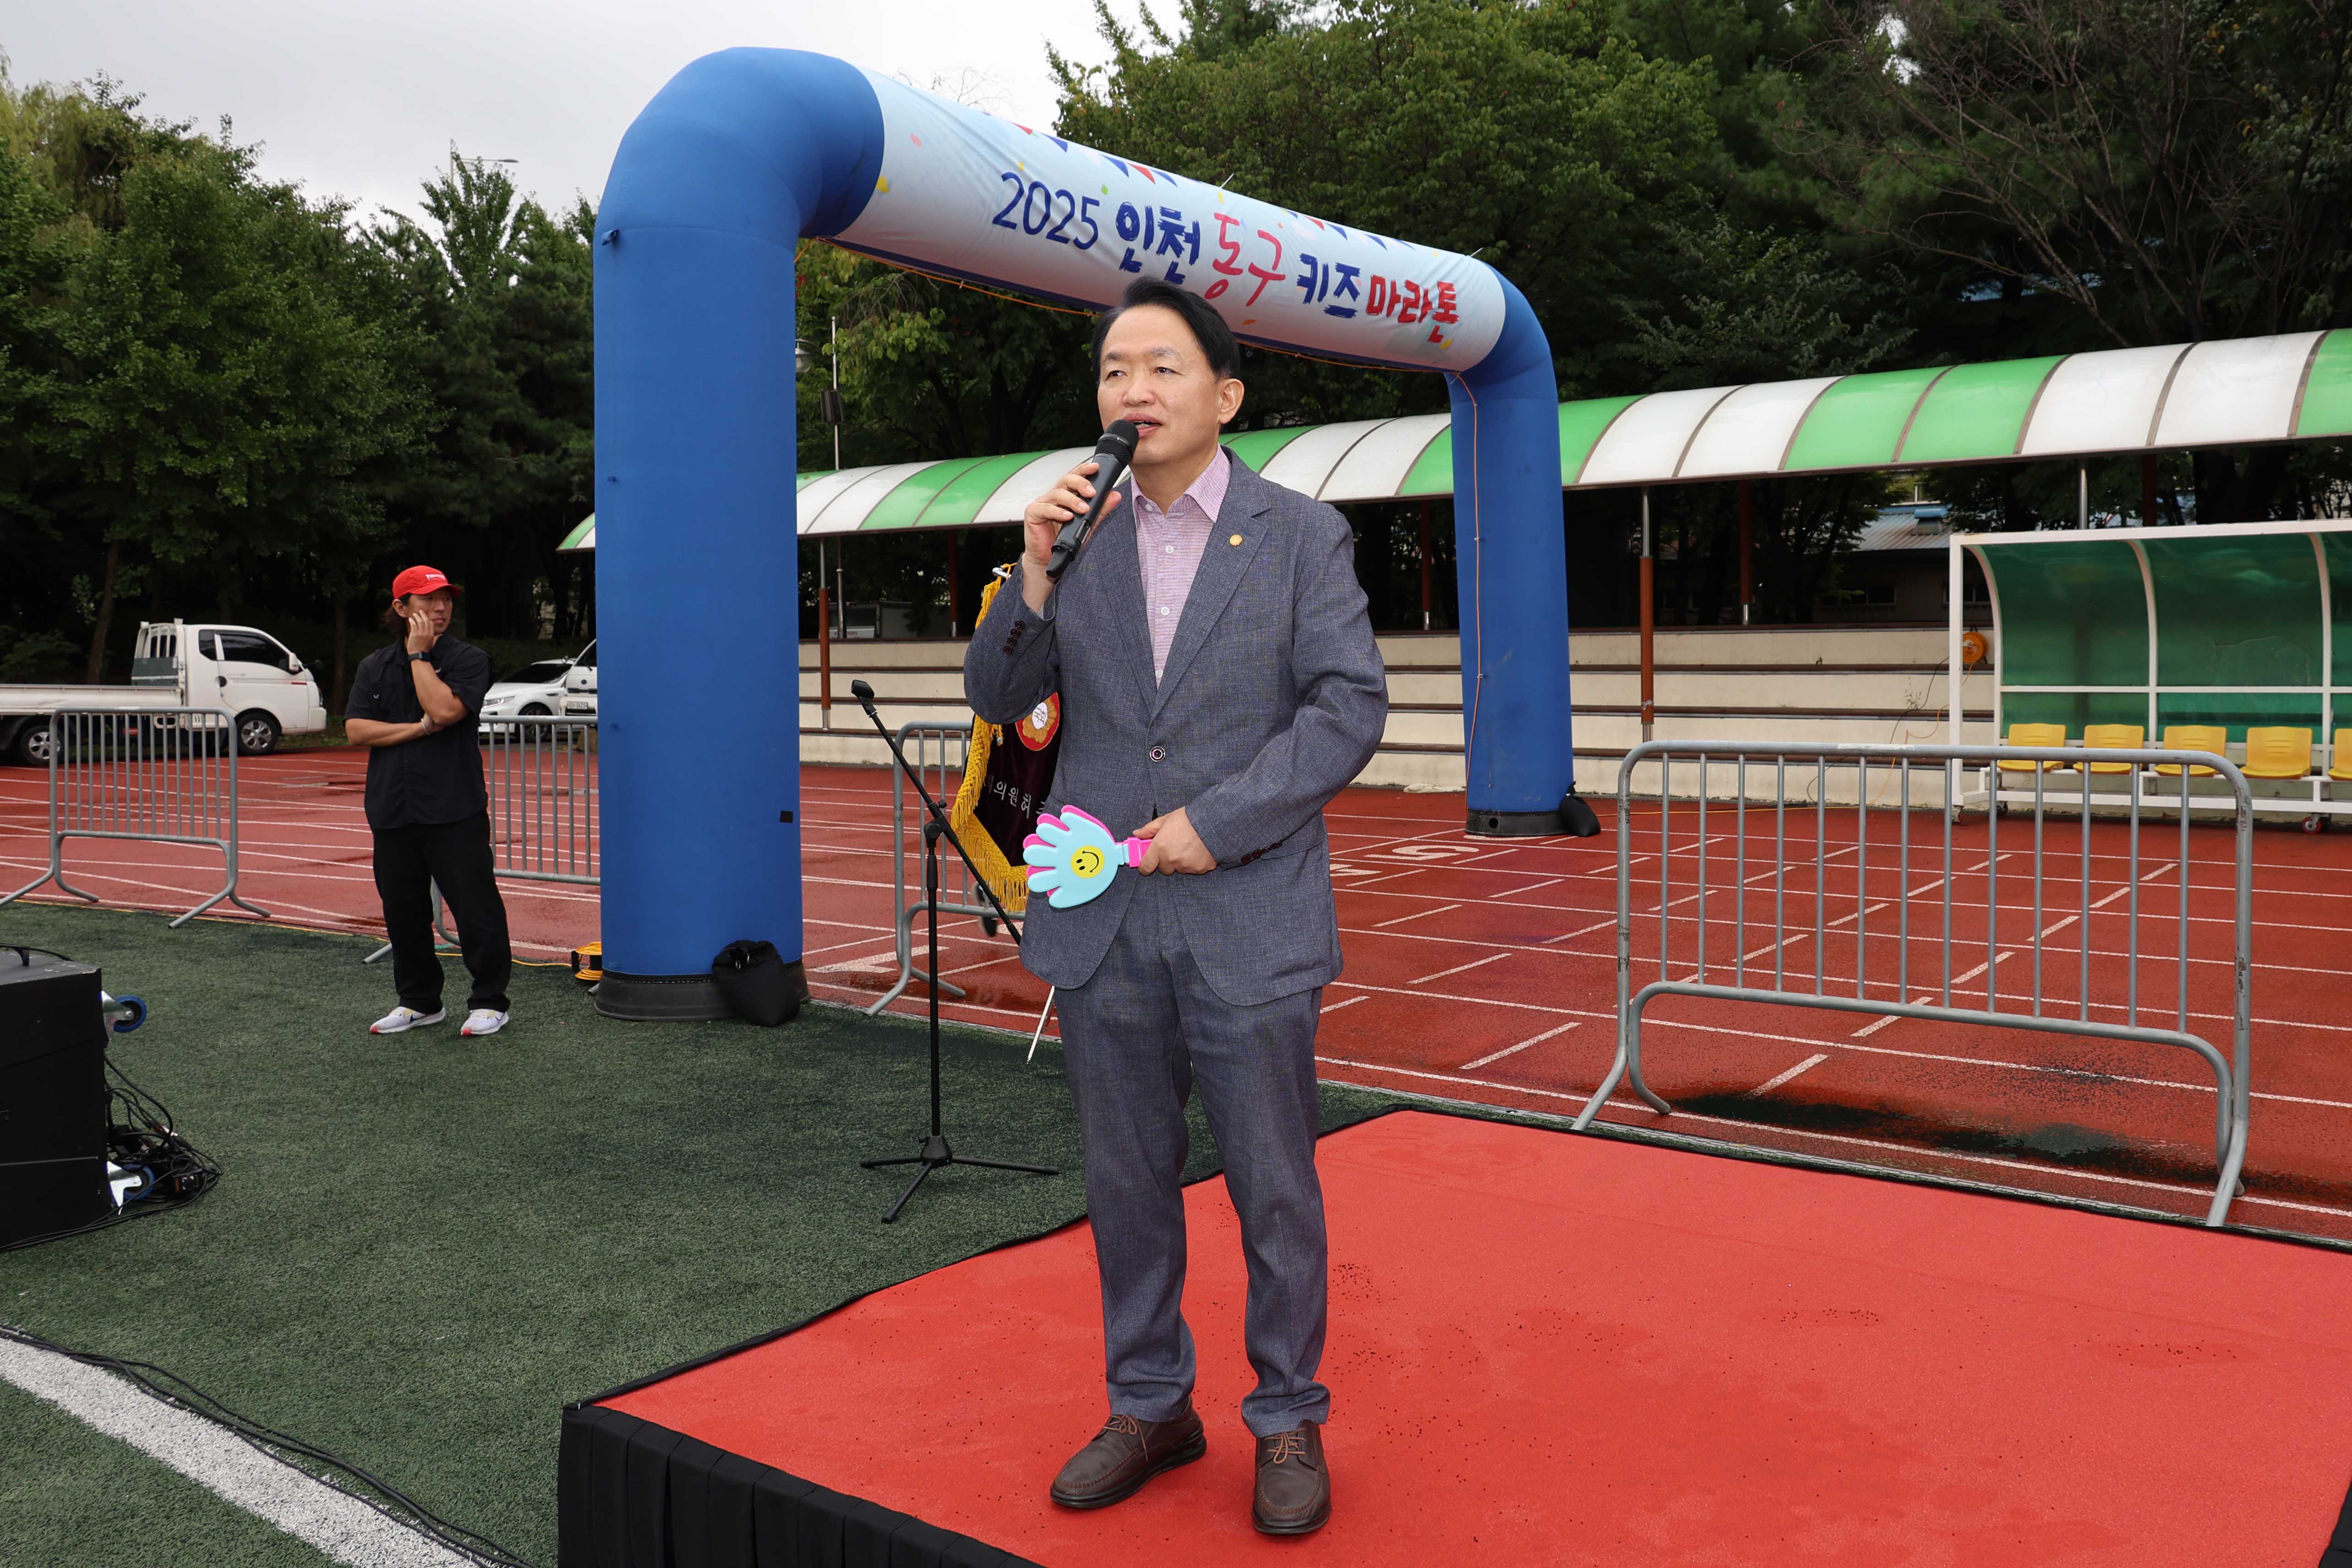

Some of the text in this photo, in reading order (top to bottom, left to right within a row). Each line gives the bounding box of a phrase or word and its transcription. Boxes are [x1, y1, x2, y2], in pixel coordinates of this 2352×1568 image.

[992, 172, 1460, 343] 2025 인천 동구 키즈 마라톤
